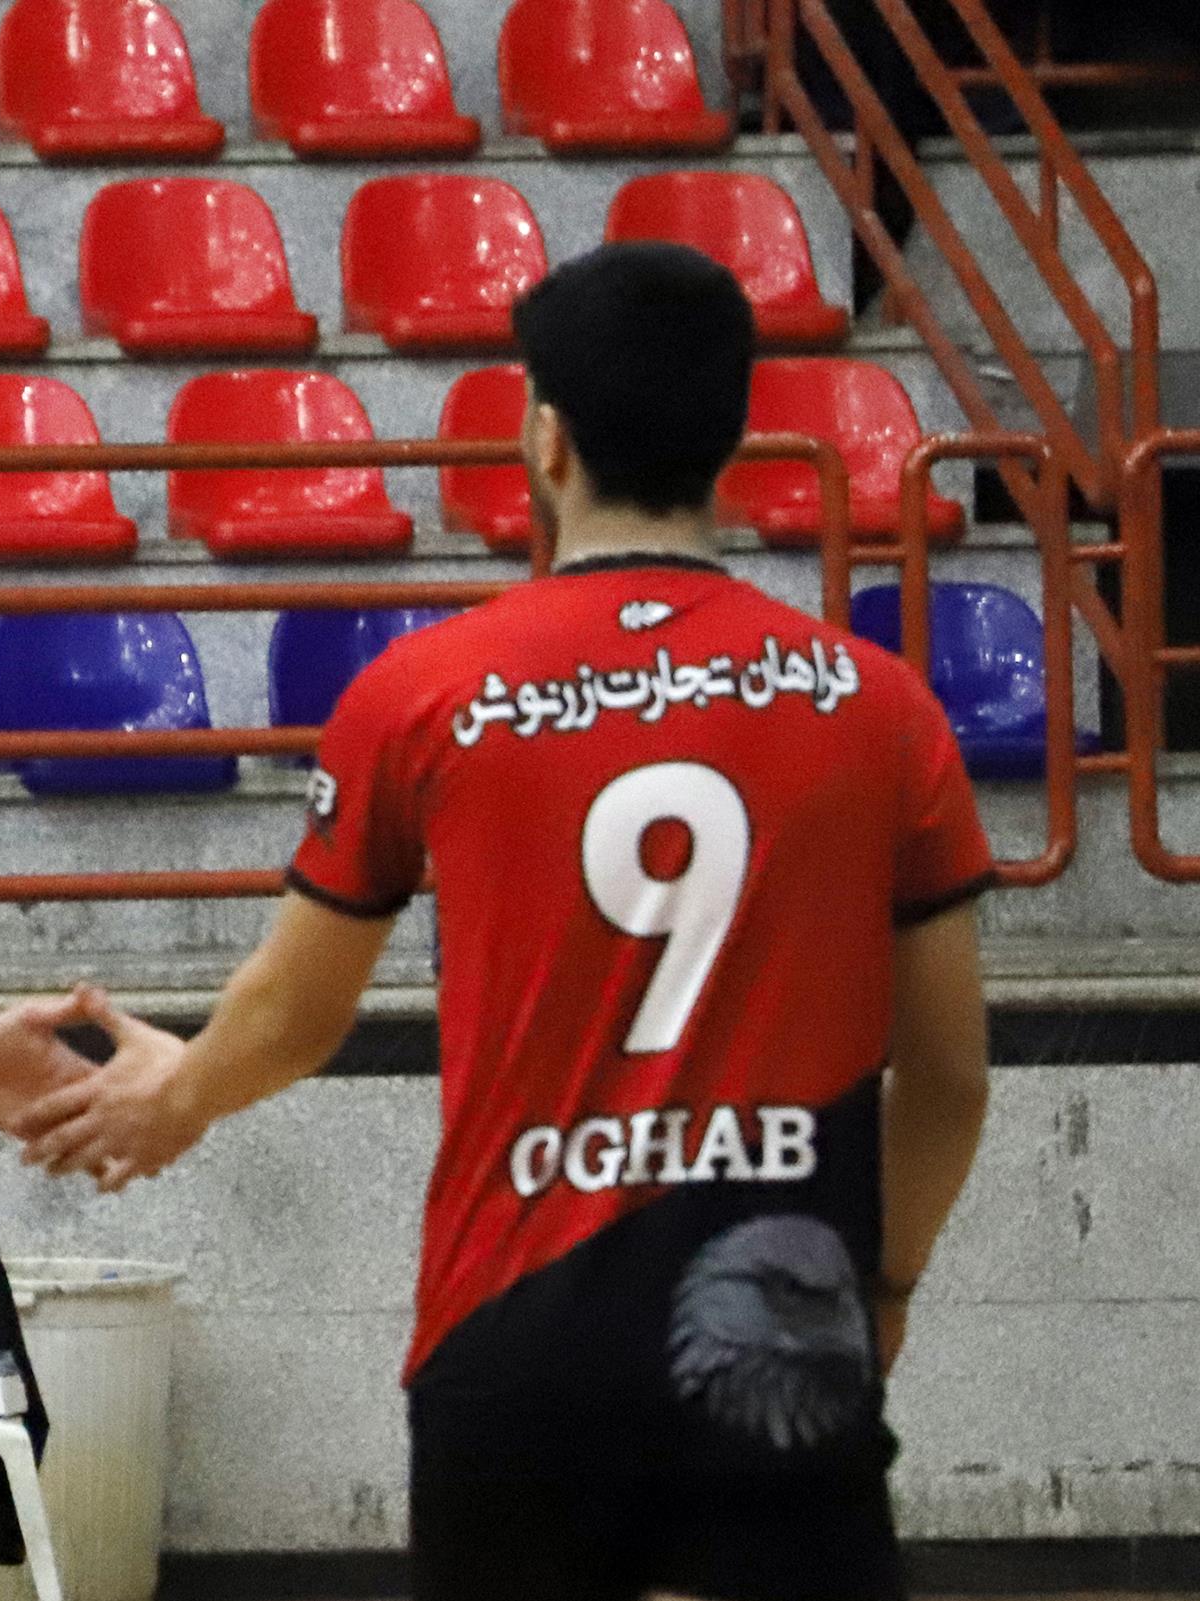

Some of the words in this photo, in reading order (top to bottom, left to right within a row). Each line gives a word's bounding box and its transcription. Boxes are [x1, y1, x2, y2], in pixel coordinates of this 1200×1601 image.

[596, 647, 736, 723] تجارت
[741, 635, 859, 713] فراهان
[582, 761, 749, 1054] 9
[510, 1105, 818, 1198] OGHAB
